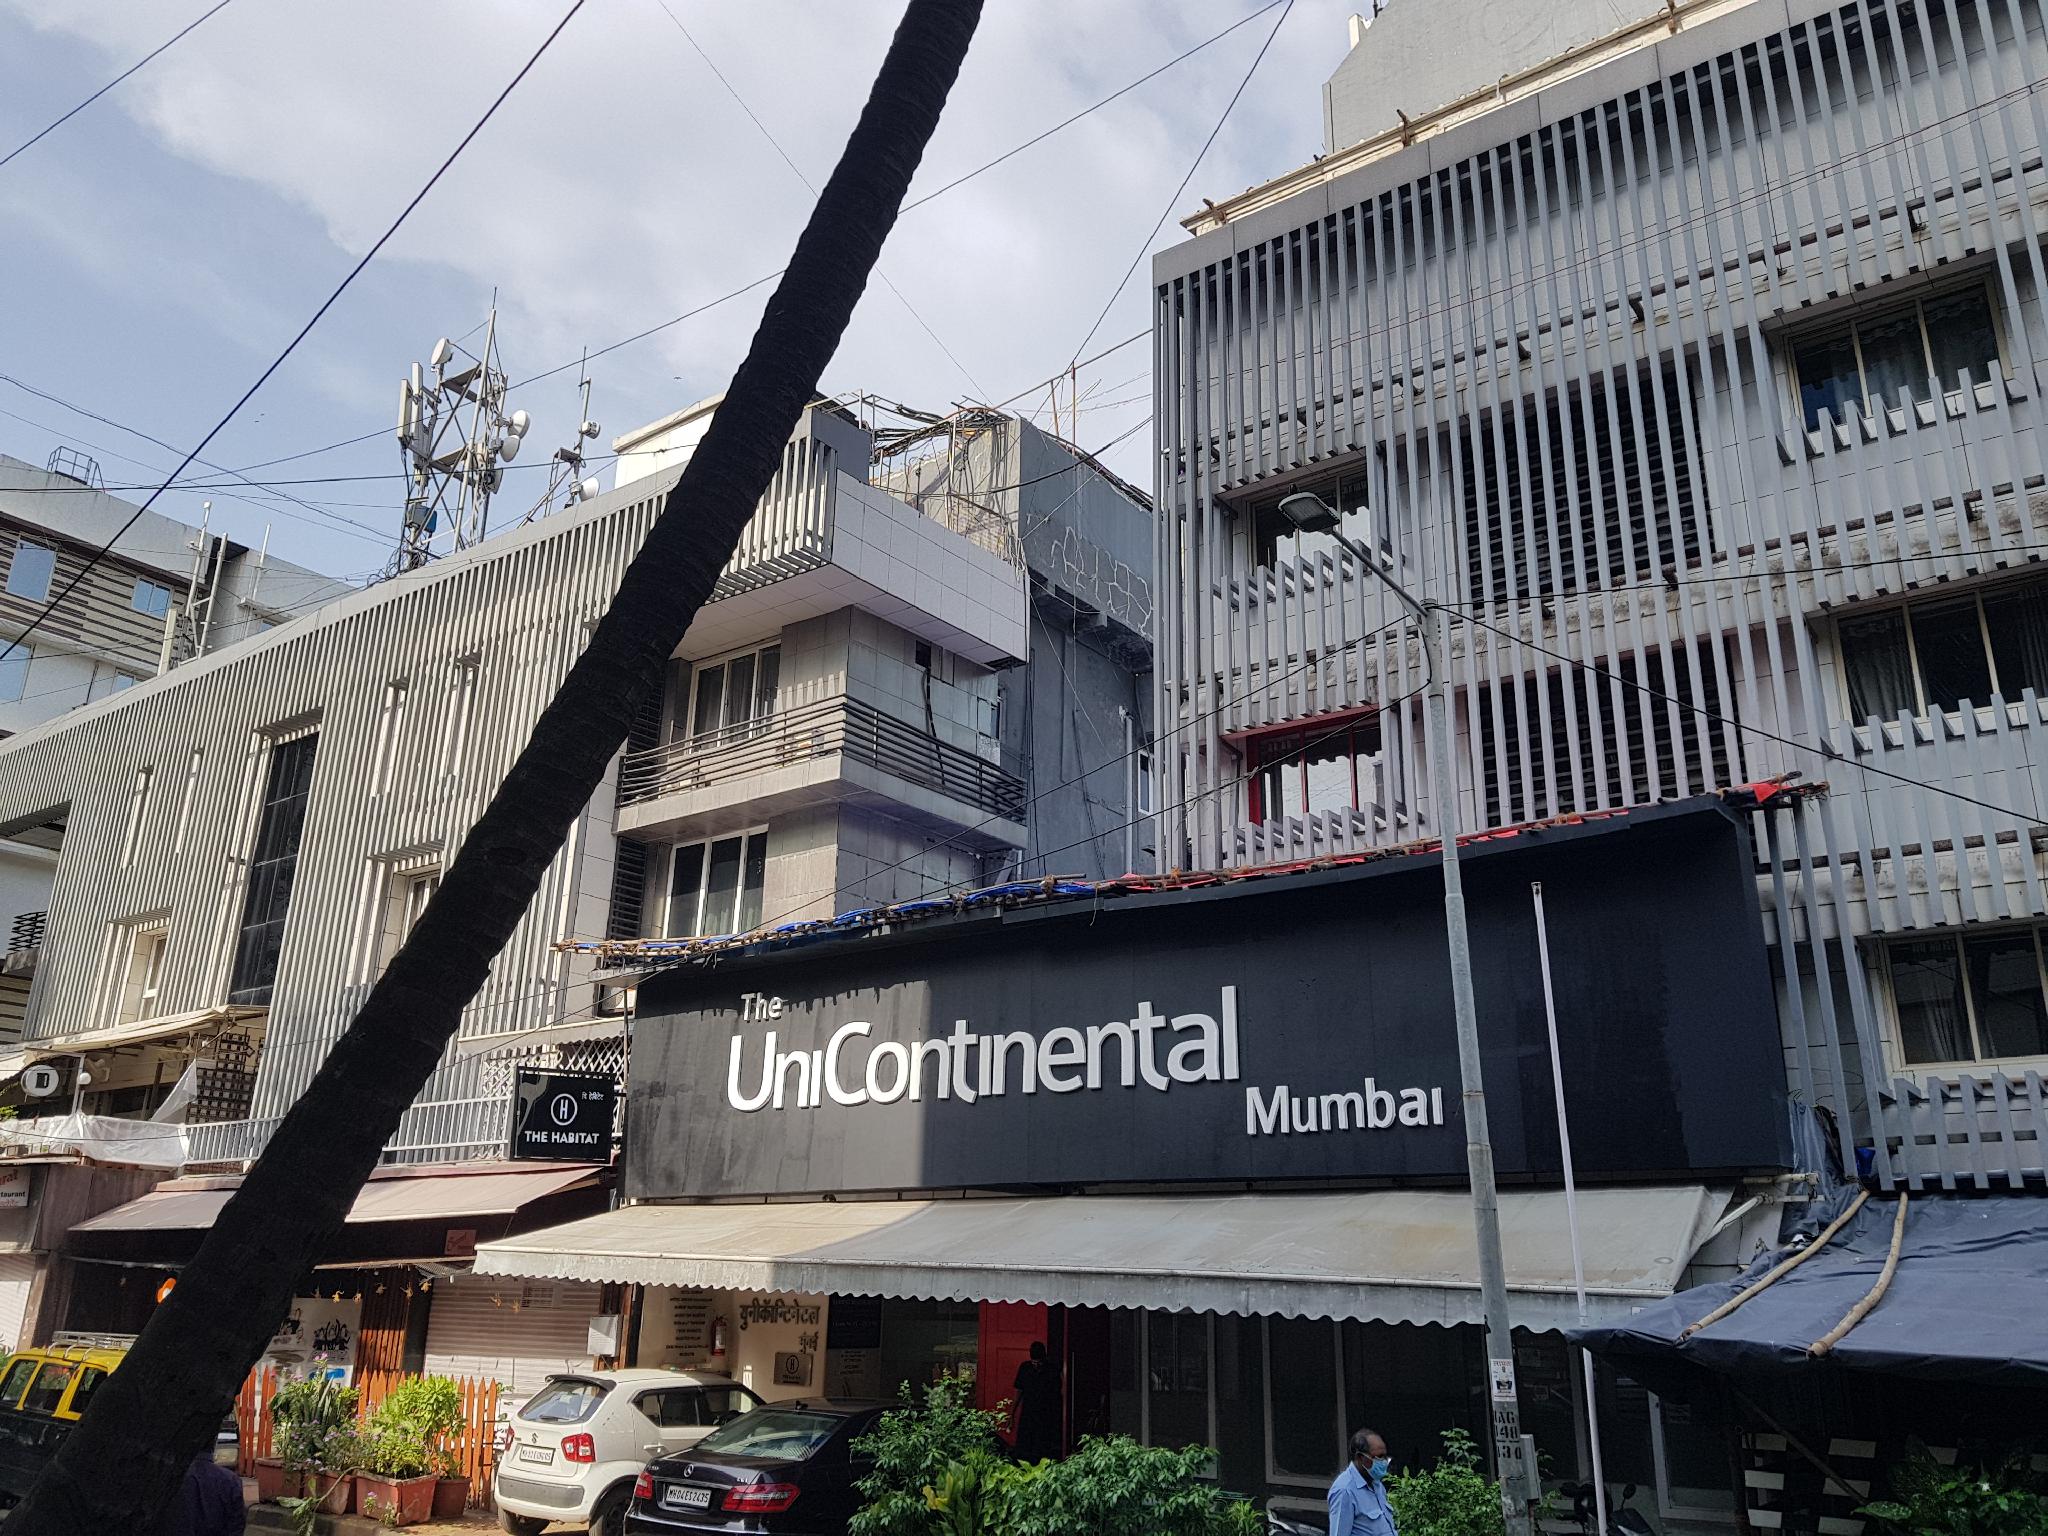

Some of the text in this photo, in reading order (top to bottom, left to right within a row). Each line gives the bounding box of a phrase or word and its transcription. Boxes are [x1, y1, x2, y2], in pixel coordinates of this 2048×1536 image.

[740, 992, 784, 1023] The
[726, 985, 1240, 1113] UniContinental
[1245, 1077, 1444, 1137] Mumbai
[524, 1130, 600, 1145] THE HABITAT
